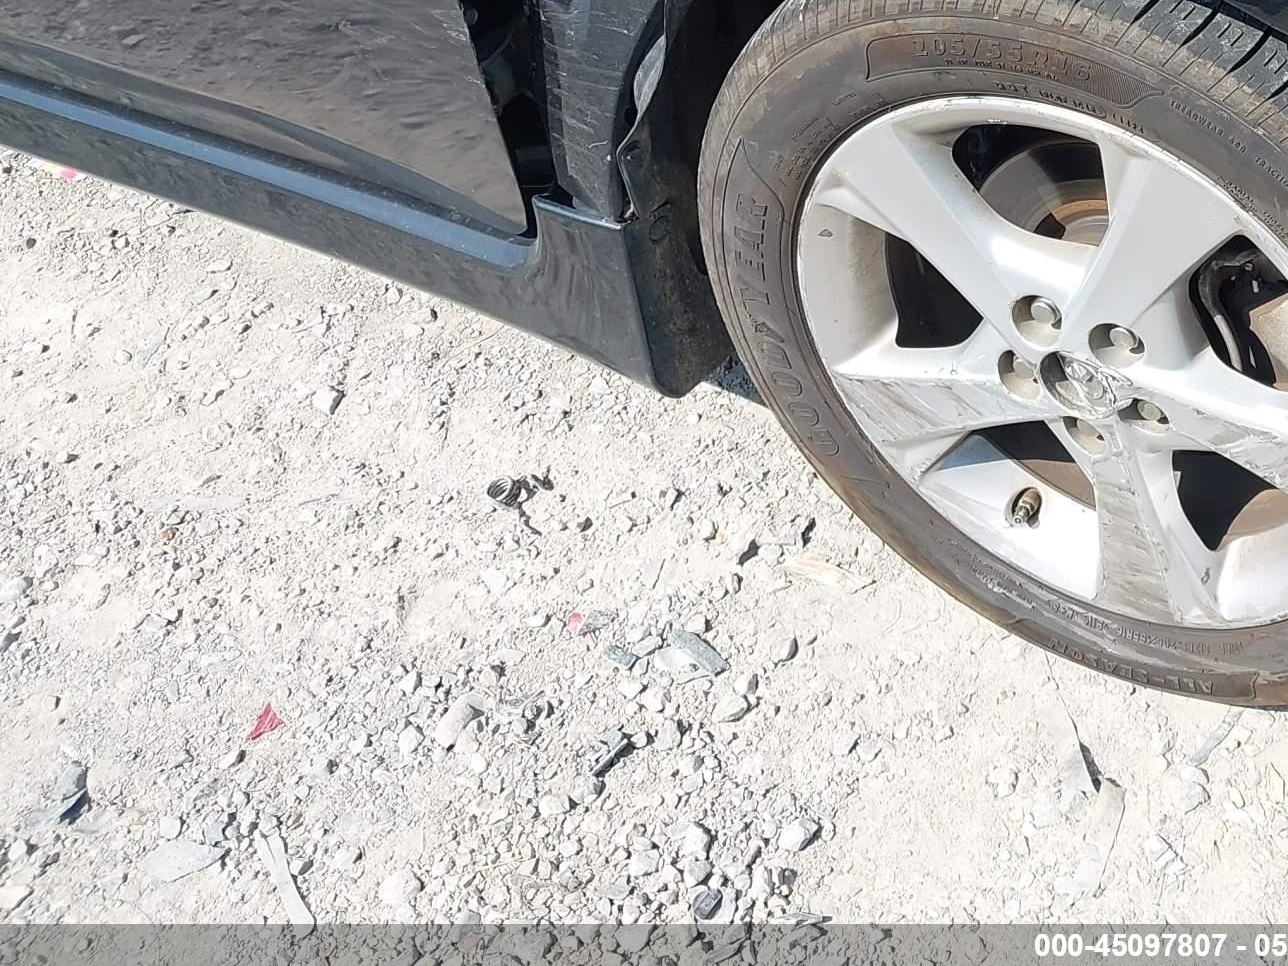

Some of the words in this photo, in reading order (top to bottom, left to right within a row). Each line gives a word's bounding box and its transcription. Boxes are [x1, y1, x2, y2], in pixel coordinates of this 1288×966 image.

[910, 37, 1091, 84] 205/55R16
[735, 192, 841, 457] GOODYEAR
[1048, 635, 1218, 693] ALL-SEASON
